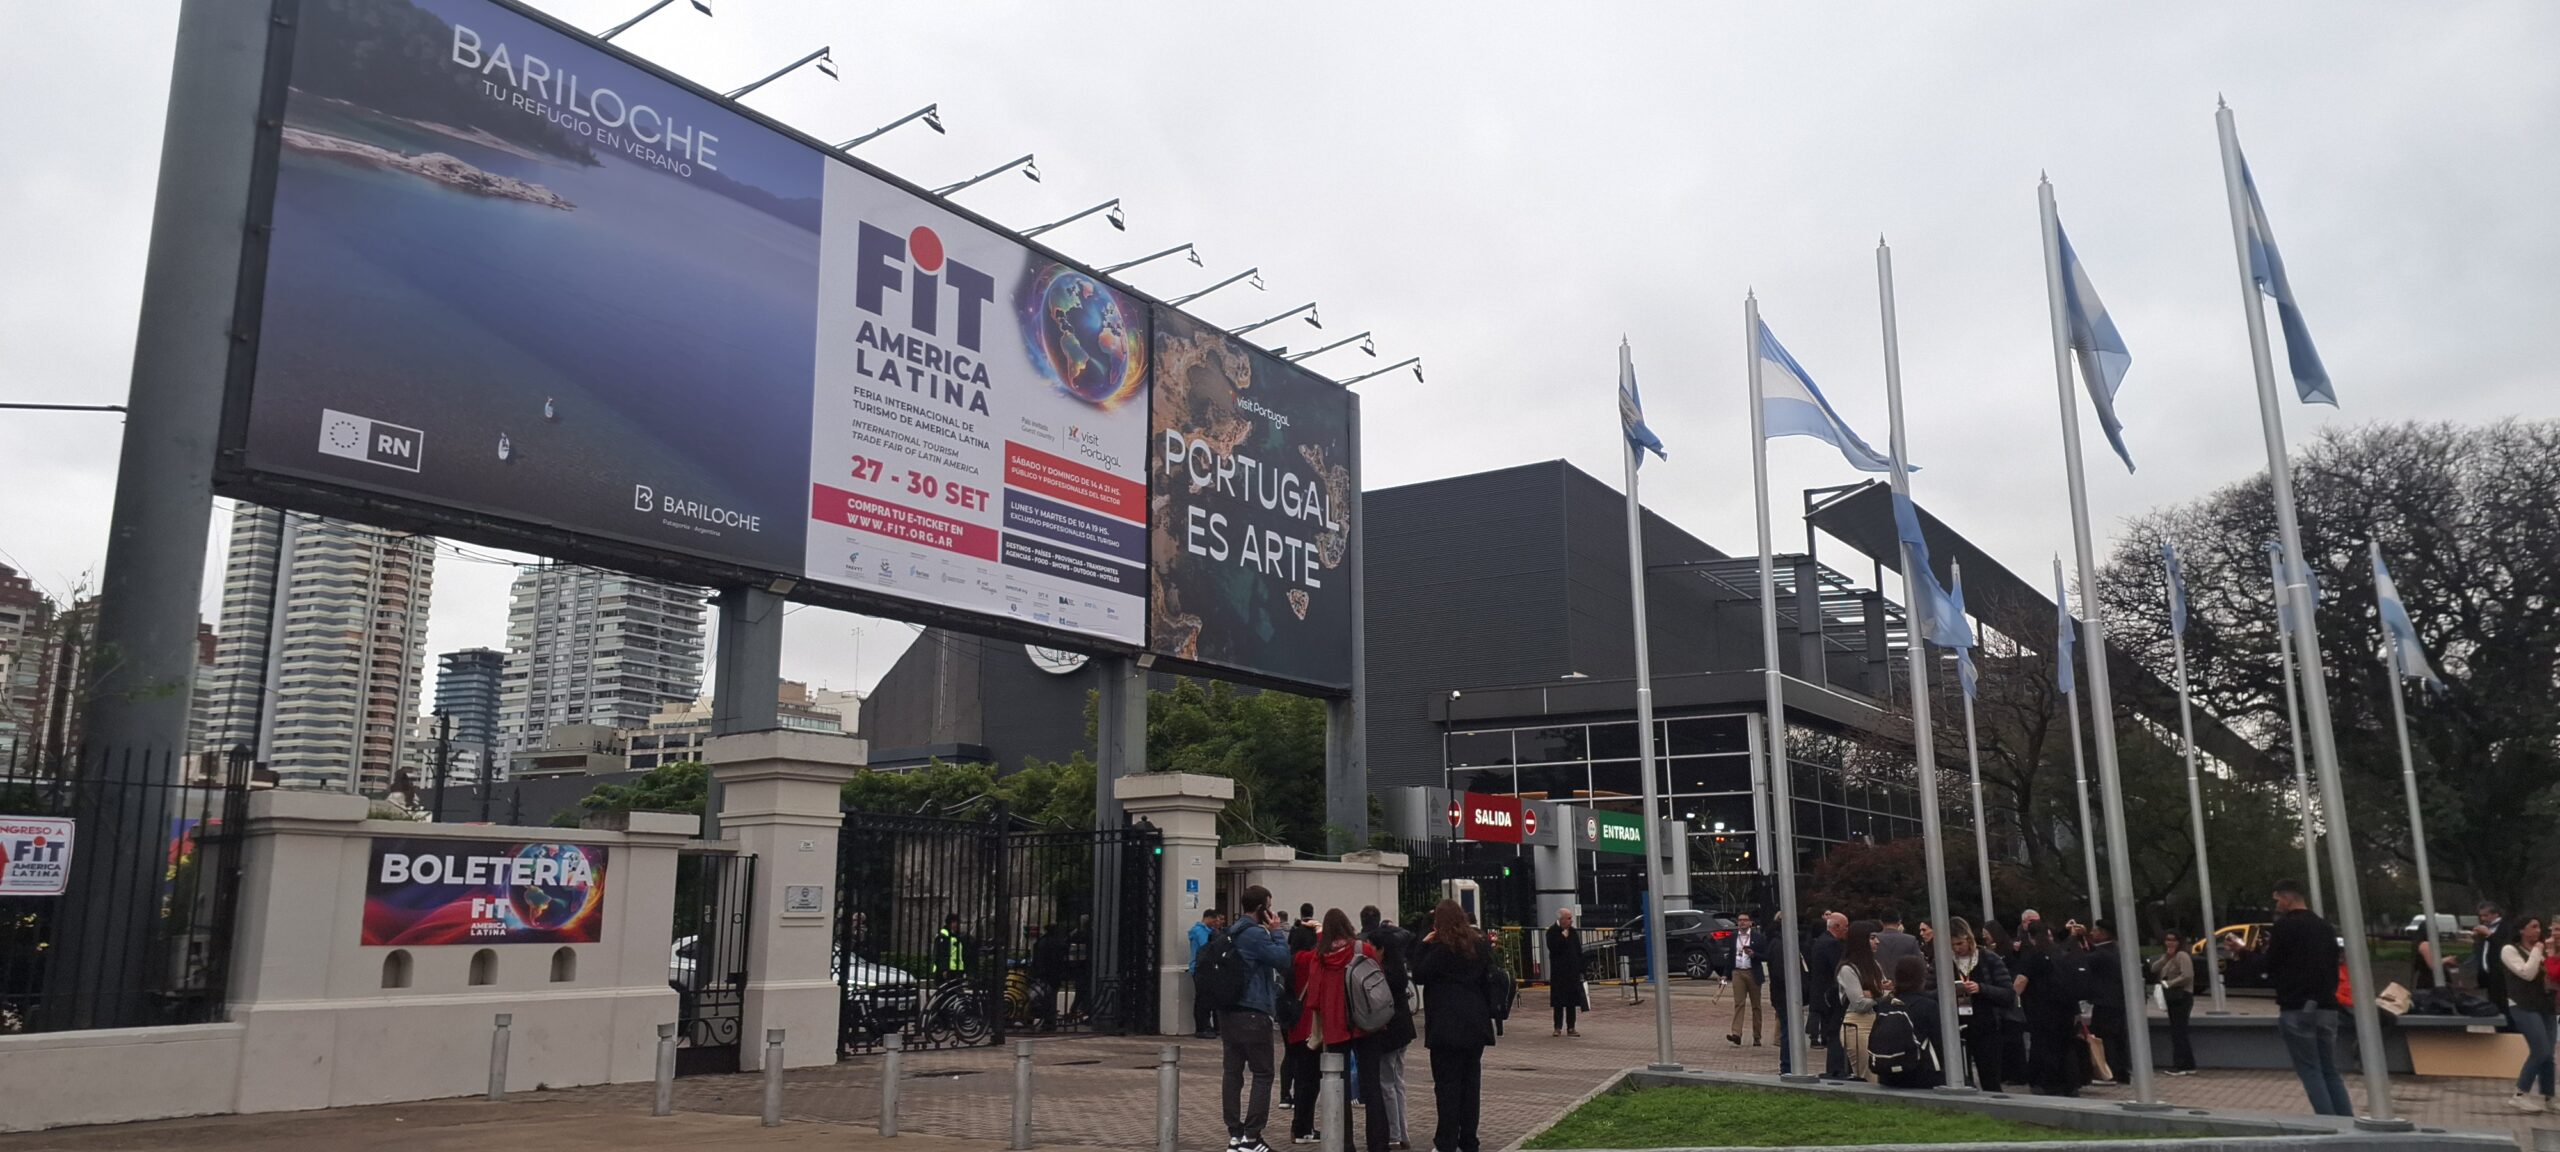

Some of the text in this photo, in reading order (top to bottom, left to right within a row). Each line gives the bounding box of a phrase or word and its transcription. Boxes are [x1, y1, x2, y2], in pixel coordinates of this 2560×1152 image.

[452, 23, 719, 172] BARILOCHE
[483, 79, 692, 178] TU REFUGIO EN VERANO
[855, 320, 991, 390] AMERICA
[856, 347, 990, 417] LATINA
[852, 399, 990, 451] TURISMO DE AMERICA LATINA
[853, 386, 975, 433] FERIA INTERNACIONAL DE
[378, 434, 411, 458] RN
[851, 430, 979, 475] TRADE FAIR OF LATIN AMERICA
[852, 418, 959, 458] INTERNATIONAL TOURISM
[851, 454, 883, 483] 27
[907, 470, 938, 498] 30
[945, 482, 990, 512] SET
[1011, 455, 1041, 471] SÁBADO
[1048, 467, 1080, 483] DOMINGO
[1081, 477, 1090, 487] DE
[1166, 428, 1340, 532] PORTUGAL
[1043, 476, 1089, 496] PROFESIONALES
[1089, 491, 1100, 499] DEL
[1100, 494, 1120, 506] SECTOR
[664, 496, 760, 532] BARILOCHE
[847, 512, 953, 548] WWW.FIT.ORG.AR
[848, 498, 963, 536] COMPRA TU E-TICKET EN
[1010, 512, 1120, 548] EXCLUSIVO PROFESIONALES DEL TURISMO
[1011, 502, 1034, 515] LUNES
[1040, 509, 1067, 524] MARTES
[1068, 518, 1077, 526] DE
[1078, 520, 1085, 529] 10
[1005, 550, 1031, 562] AGENCIAS
[1035, 557, 1049, 566] FOOD
[1052, 561, 1070, 571] SHOWS
[1073, 567, 1096, 578] OUTDOOR
[1006, 541, 1031, 554] DESTINOS
[1055, 554, 1083, 567] PROVINCIAS
[1086, 562, 1119, 575] TRANSPORTES
[1188, 505, 1321, 588] ES ARTE
[0, 825, 52, 835] NGRESO
[1475, 808, 1512, 827] SALIDA
[1603, 825, 1640, 841] ENTRADA
[381, 852, 594, 886] BOLETERÍA
